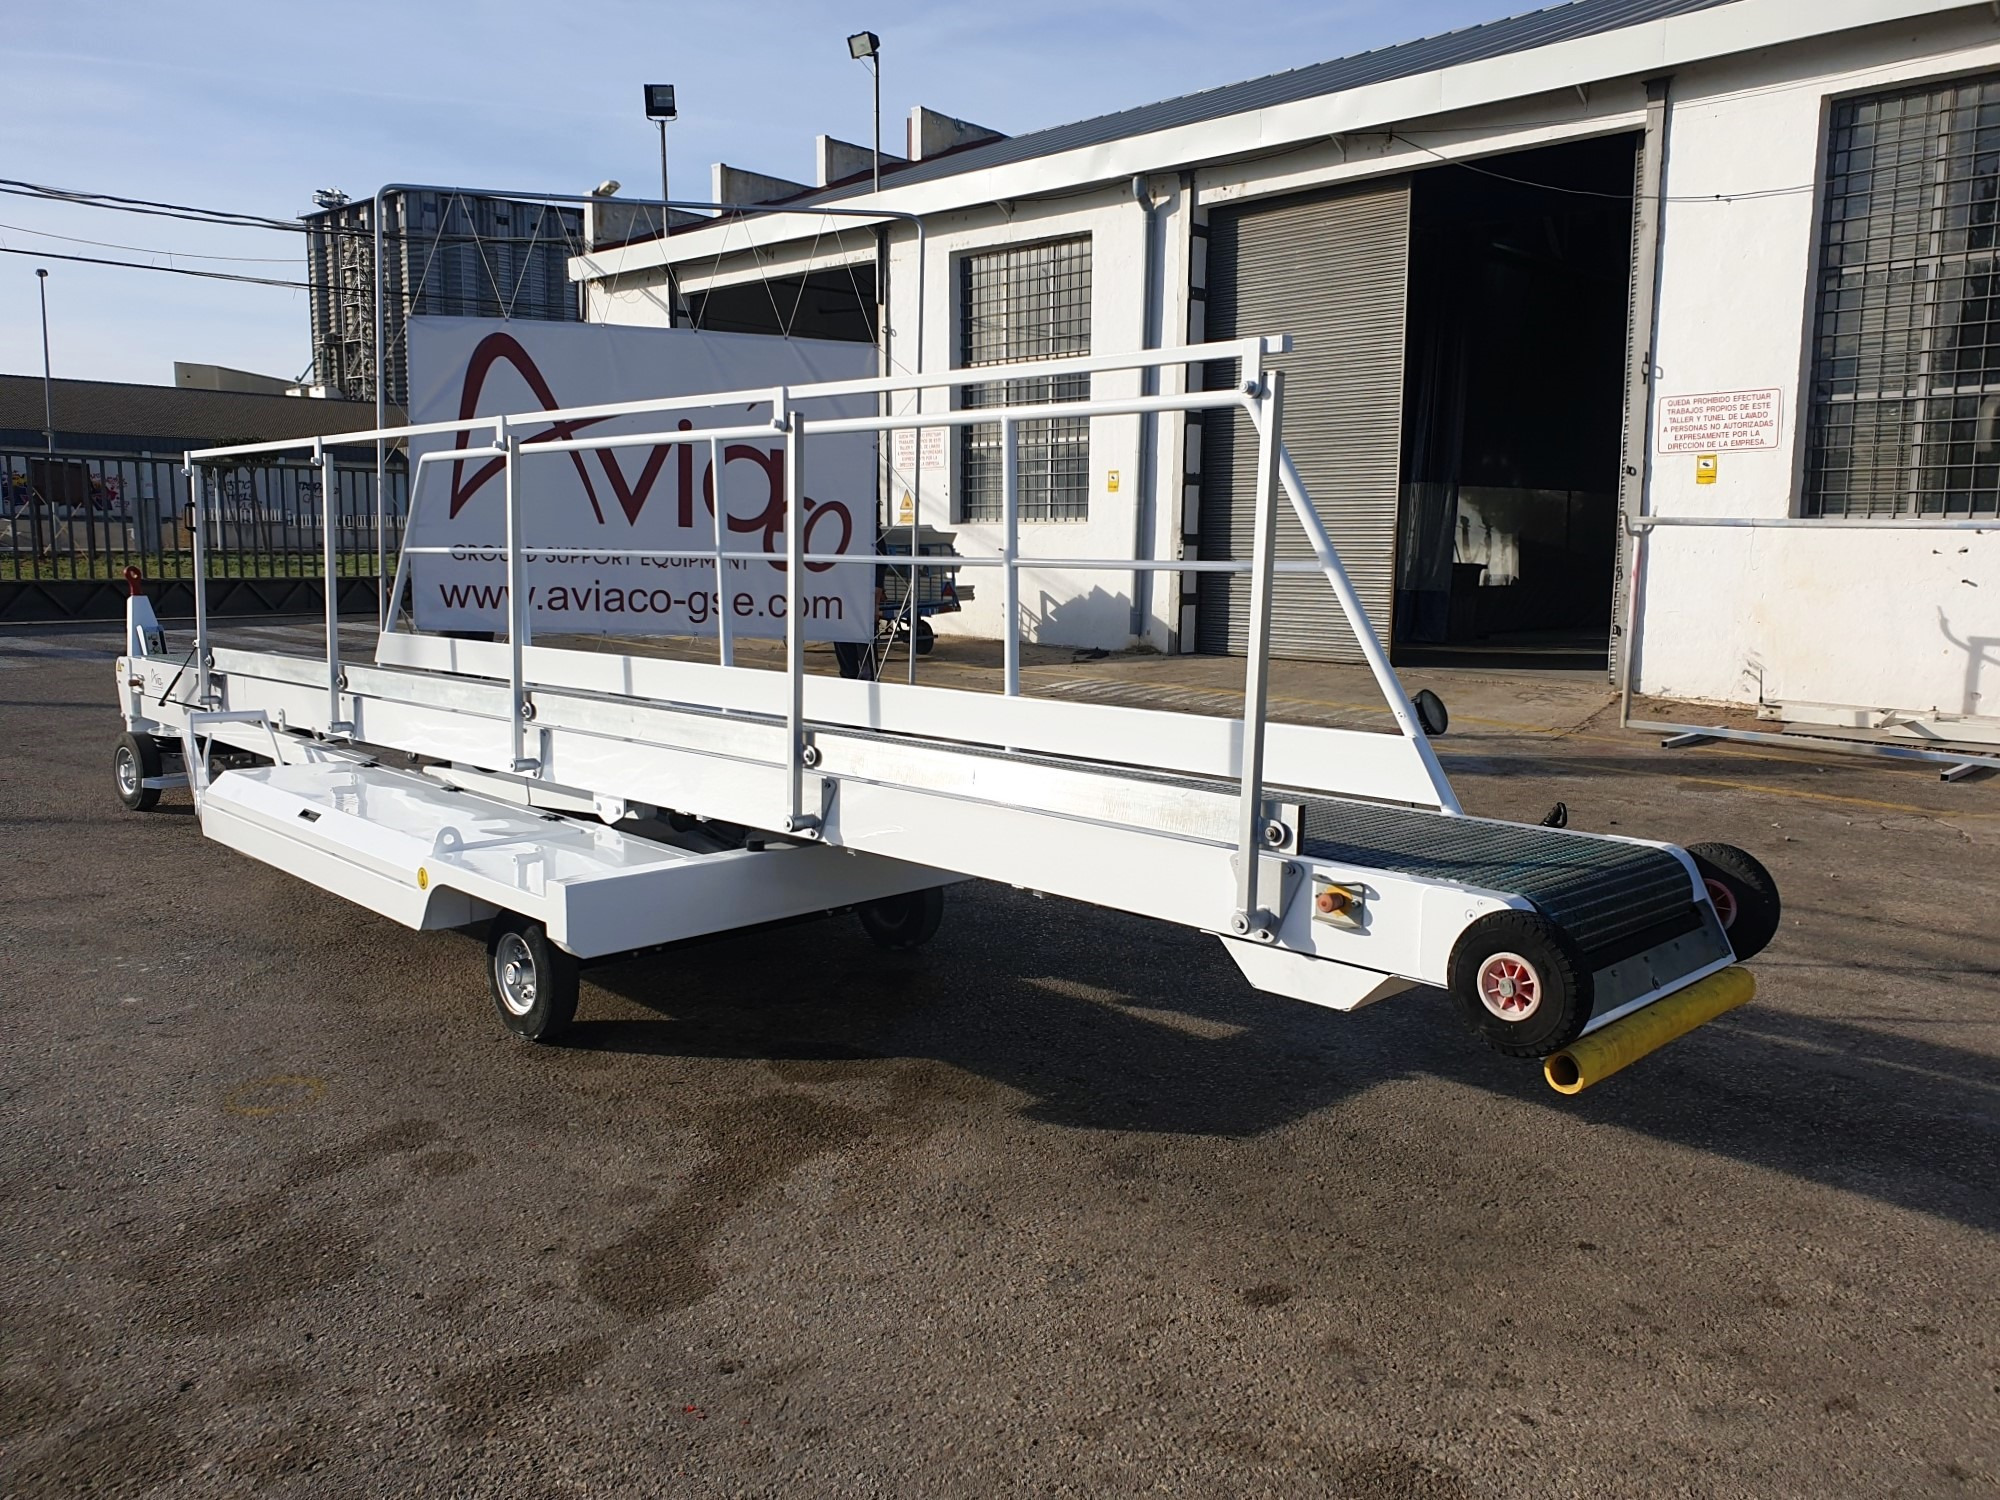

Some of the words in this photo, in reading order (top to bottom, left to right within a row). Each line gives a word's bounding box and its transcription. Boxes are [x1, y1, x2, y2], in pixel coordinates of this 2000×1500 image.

[1667, 399, 1691, 407] QUEDA
[1693, 396, 1731, 406] PROHIBIDO
[1733, 392, 1772, 402] EFECTUAR
[1667, 406, 1704, 415] TRABAJOS
[1706, 404, 1738, 413] PROPIOS
[1739, 403, 1750, 411] DE
[1752, 402, 1772, 410] ESTE
[1669, 415, 1694, 424] TALLER
[1703, 413, 1726, 422] TUNEL
[1740, 411, 1769, 420] LAVADO
[1670, 423, 1708, 433] PERSONAS
[1723, 419, 1774, 430] AUTORIZADAS
[1674, 431, 1730, 441] EXPRESAMENTE
[1732, 430, 1748, 438] POR
[1750, 429, 1761, 437] LA
[1706, 440, 1717, 448] DE
[1718, 440, 1728, 448] LA
[451, 543, 538, 563] GROUD
[641, 549, 748, 571] EQUIPMNT
[439, 578, 843, 624] ww.aviaco-ge.cm
